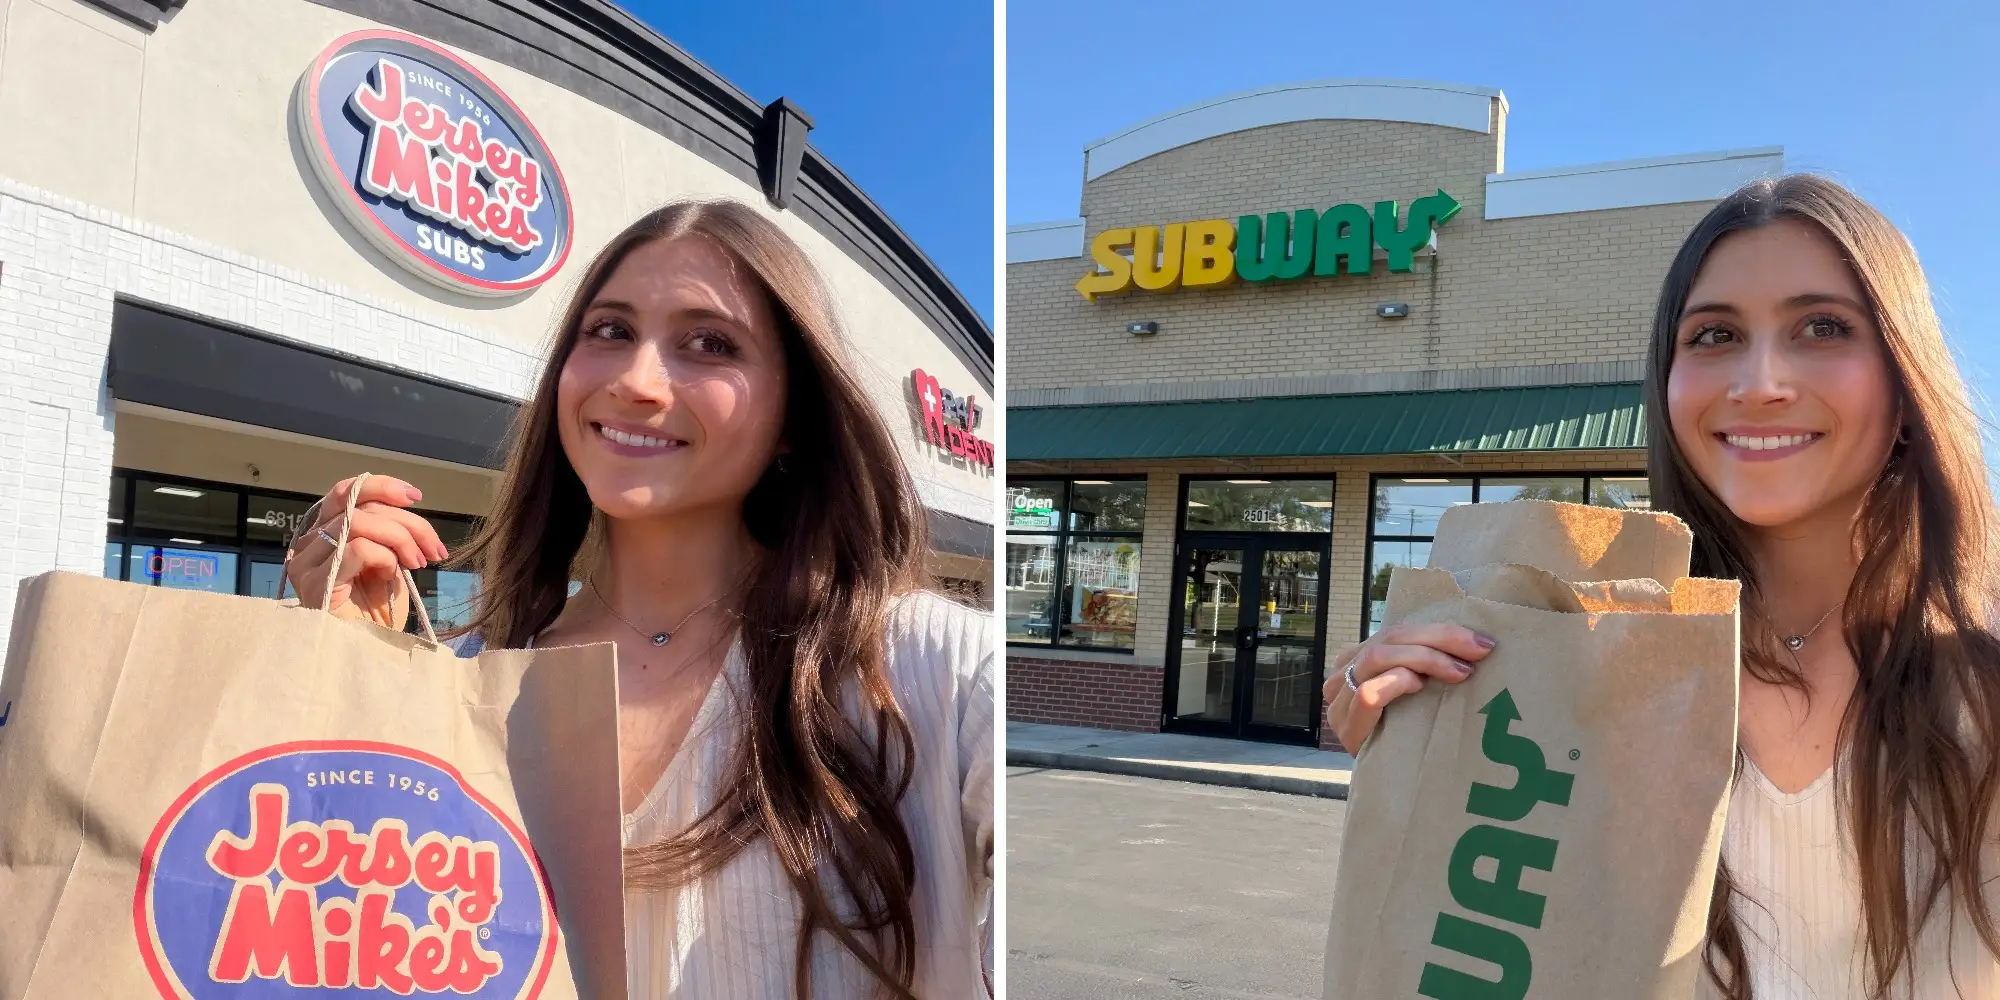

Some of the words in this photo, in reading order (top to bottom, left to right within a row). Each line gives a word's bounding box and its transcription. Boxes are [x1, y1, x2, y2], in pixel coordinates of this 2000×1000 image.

[408, 71, 452, 97] SINCE
[460, 93, 491, 126] 1956
[355, 60, 541, 207] Jersey
[368, 123, 542, 250] Mike's
[416, 224, 486, 272] SUBS
[1074, 188, 1462, 303] SUBWAY
[1014, 494, 1053, 513] Open
[1244, 510, 1269, 522] 2501
[149, 555, 214, 577] OPEN
[307, 769, 374, 788] SINCE
[388, 772, 439, 802] 1956
[207, 784, 501, 923] Jersey
[212, 883, 503, 995] Mike's
